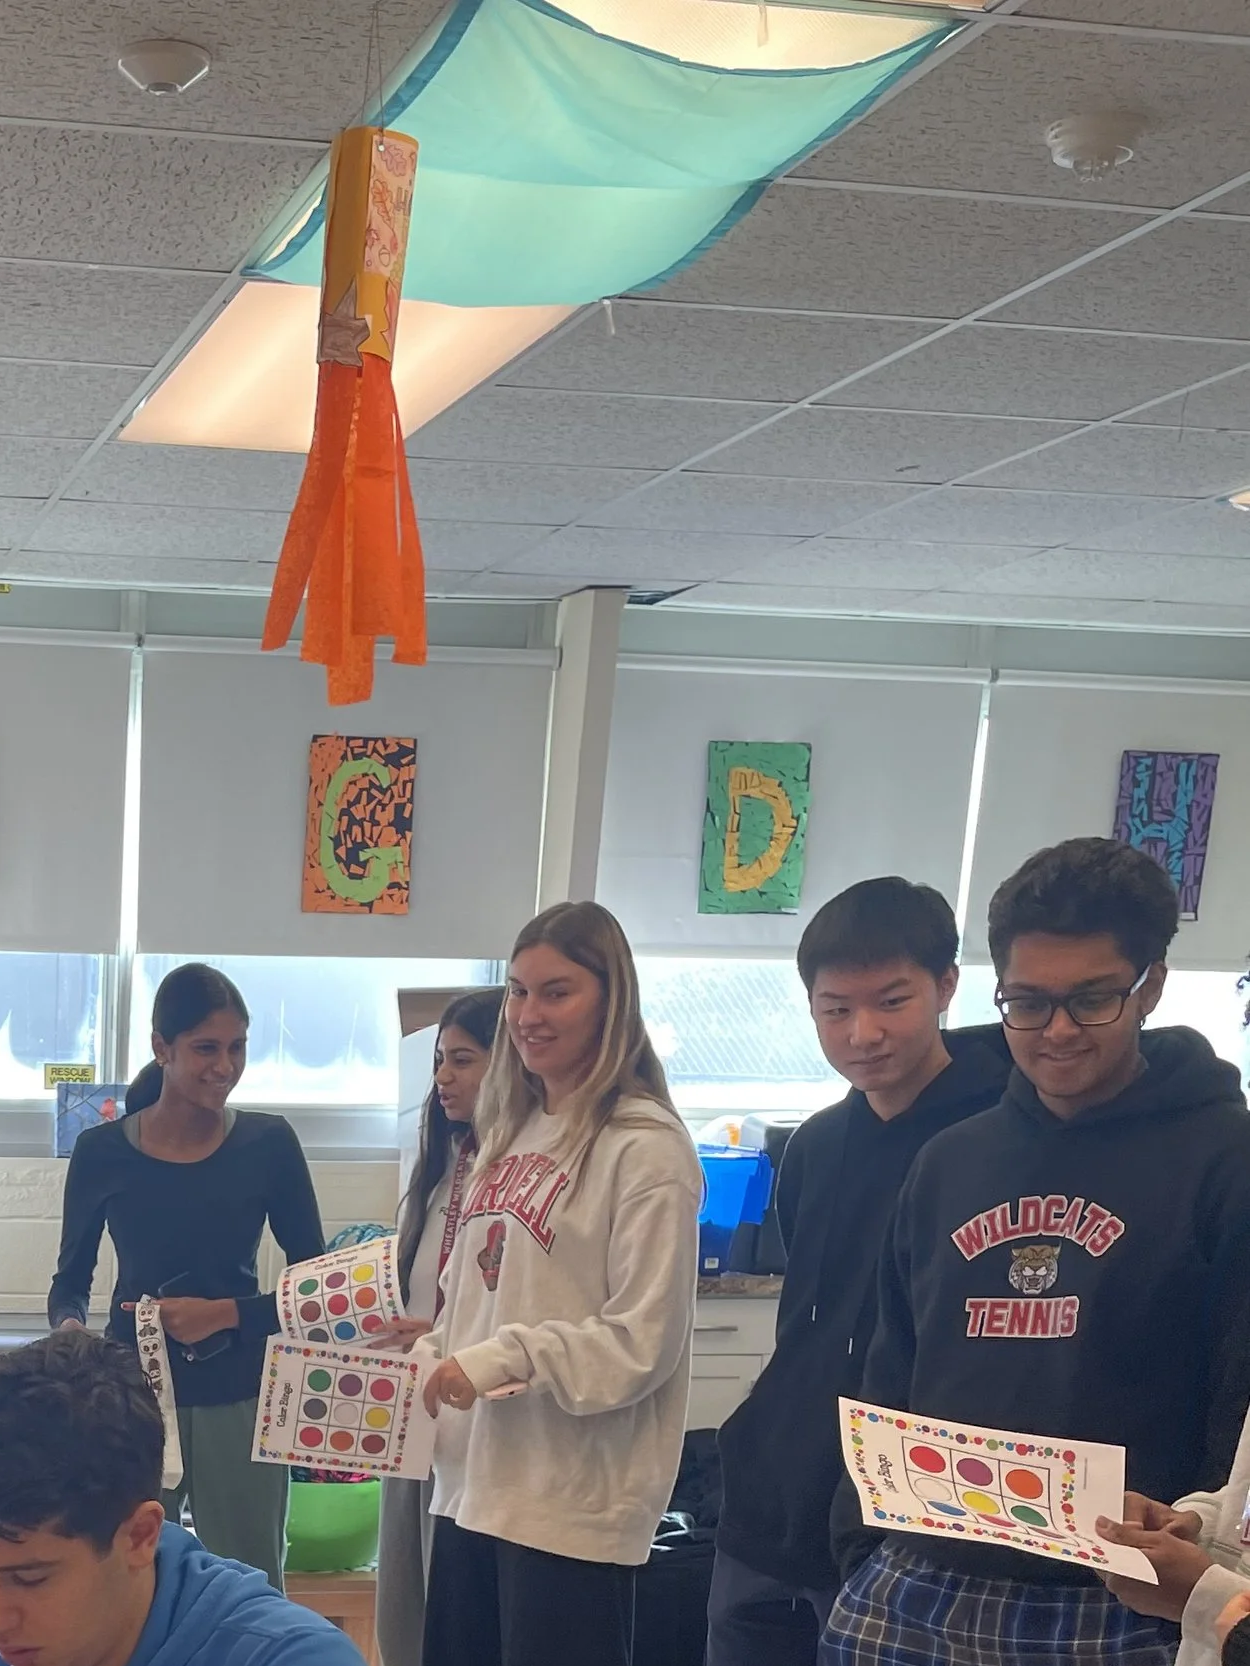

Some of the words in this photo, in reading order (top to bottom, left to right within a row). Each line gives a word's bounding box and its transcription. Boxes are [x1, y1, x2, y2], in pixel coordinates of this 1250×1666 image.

[319, 757, 406, 903] G
[724, 766, 797, 892] D
[50, 1067, 90, 1077] RESCUE
[950, 1195, 1125, 1261] WILDCATS
[965, 1296, 1079, 1338] TENNIS
[276, 1405, 288, 1428] Color
[282, 1382, 294, 1406] Bingo
